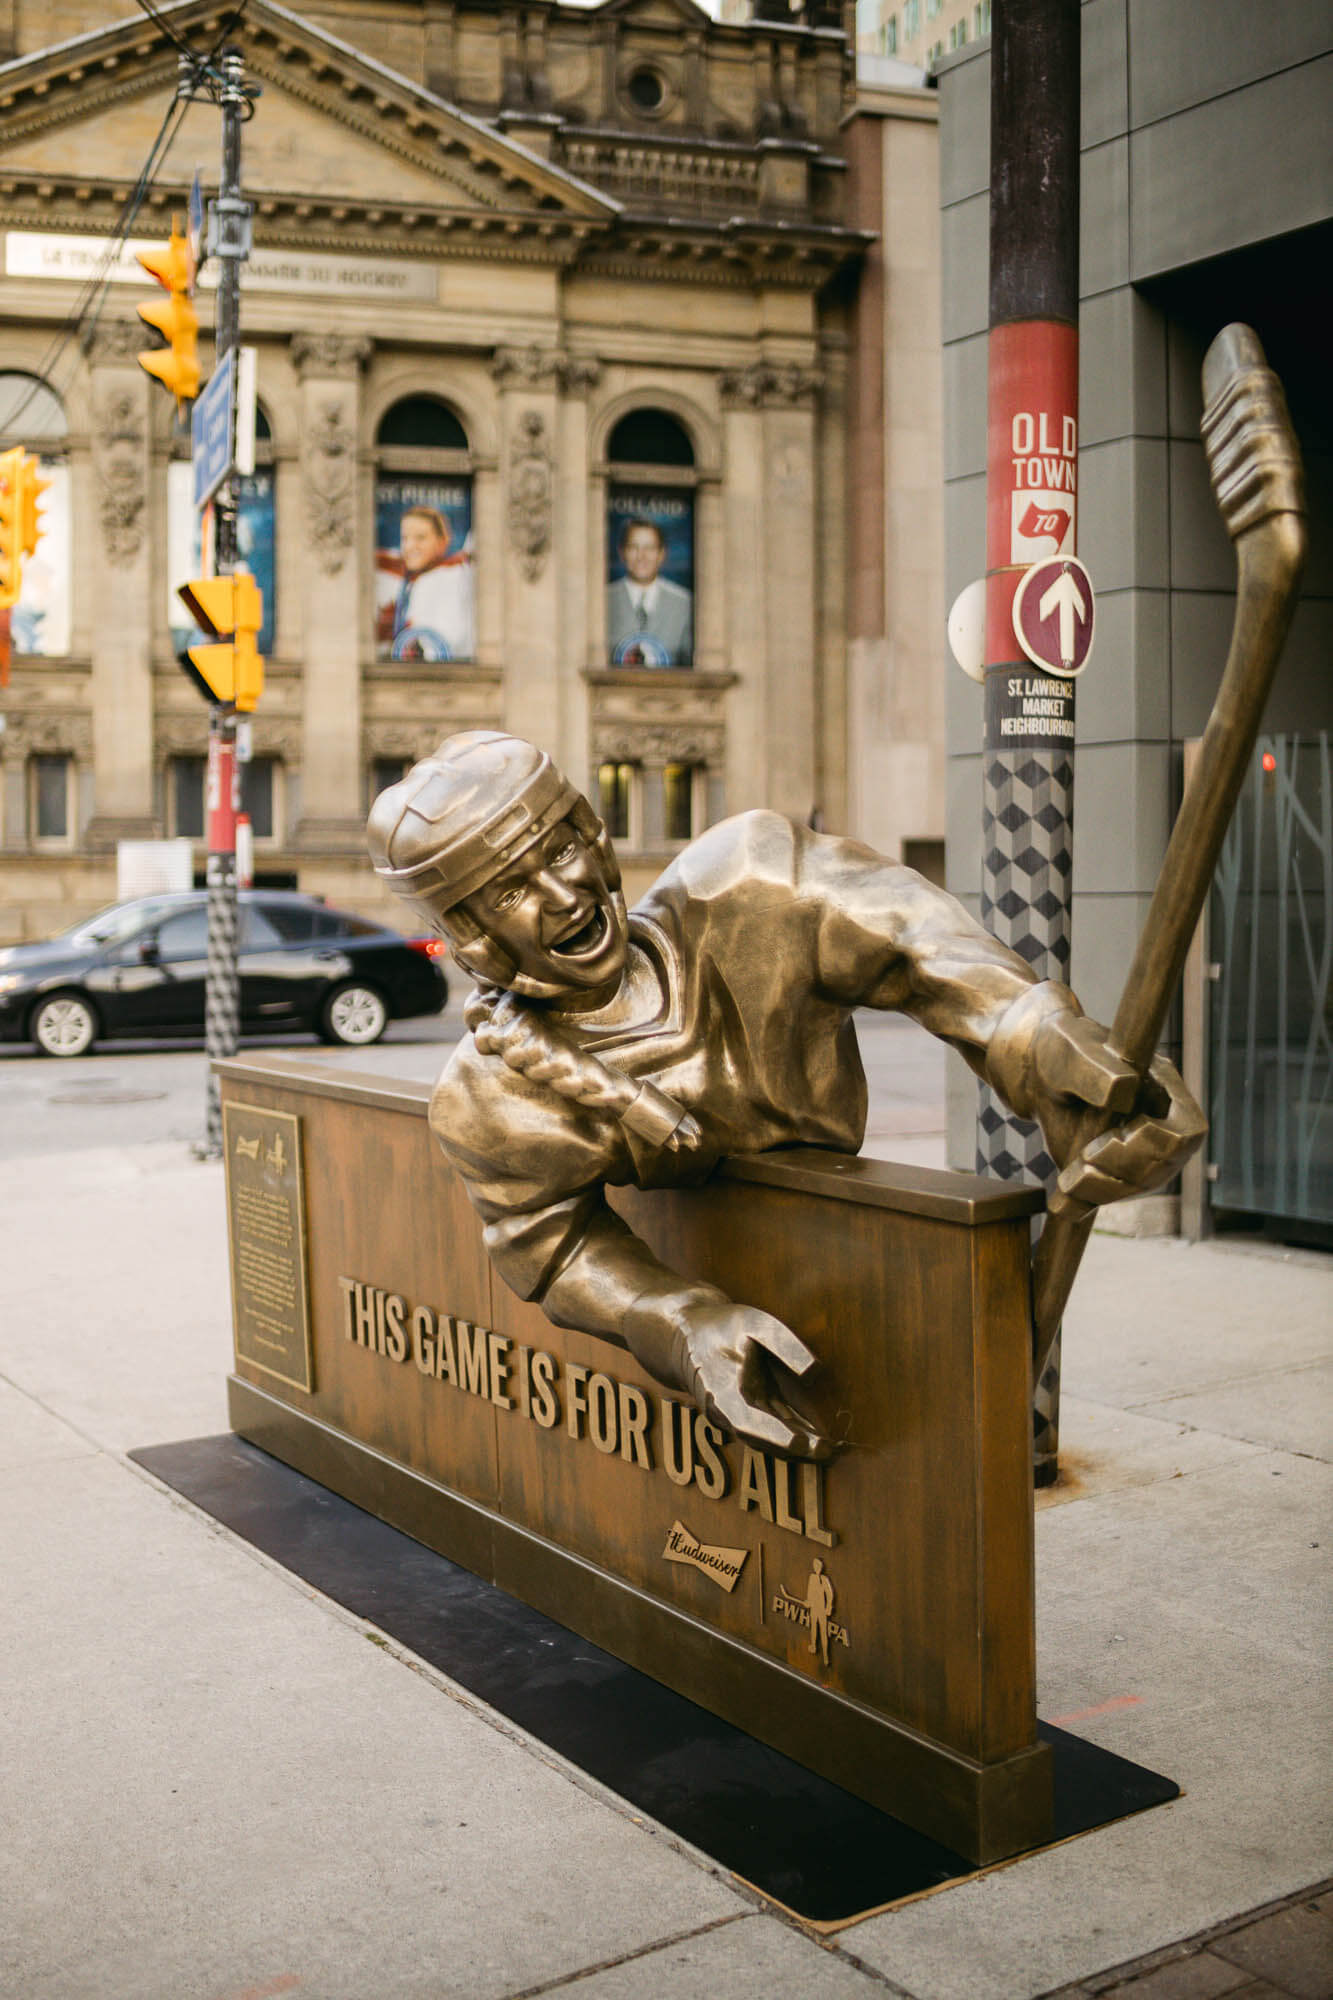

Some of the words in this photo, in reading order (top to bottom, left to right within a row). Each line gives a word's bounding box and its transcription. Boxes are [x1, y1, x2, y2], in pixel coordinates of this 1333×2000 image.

[1012, 412, 1076, 458] OLD
[1012, 457, 1075, 491] TOWN
[613, 498, 684, 516] OLLAND
[1033, 514, 1059, 533] TO
[1008, 679, 1023, 697] ST.
[1025, 679, 1073, 699] LAWRENCE
[1023, 698, 1064, 717] MARKET
[338, 1276, 407, 1363] THIS
[413, 1305, 515, 1411] GAME
[520, 1345, 561, 1429] IS
[566, 1362, 653, 1471] FOR
[662, 1399, 728, 1500] US
[739, 1443, 836, 1548] ALL
[664, 1529, 742, 1578] Budweiser
